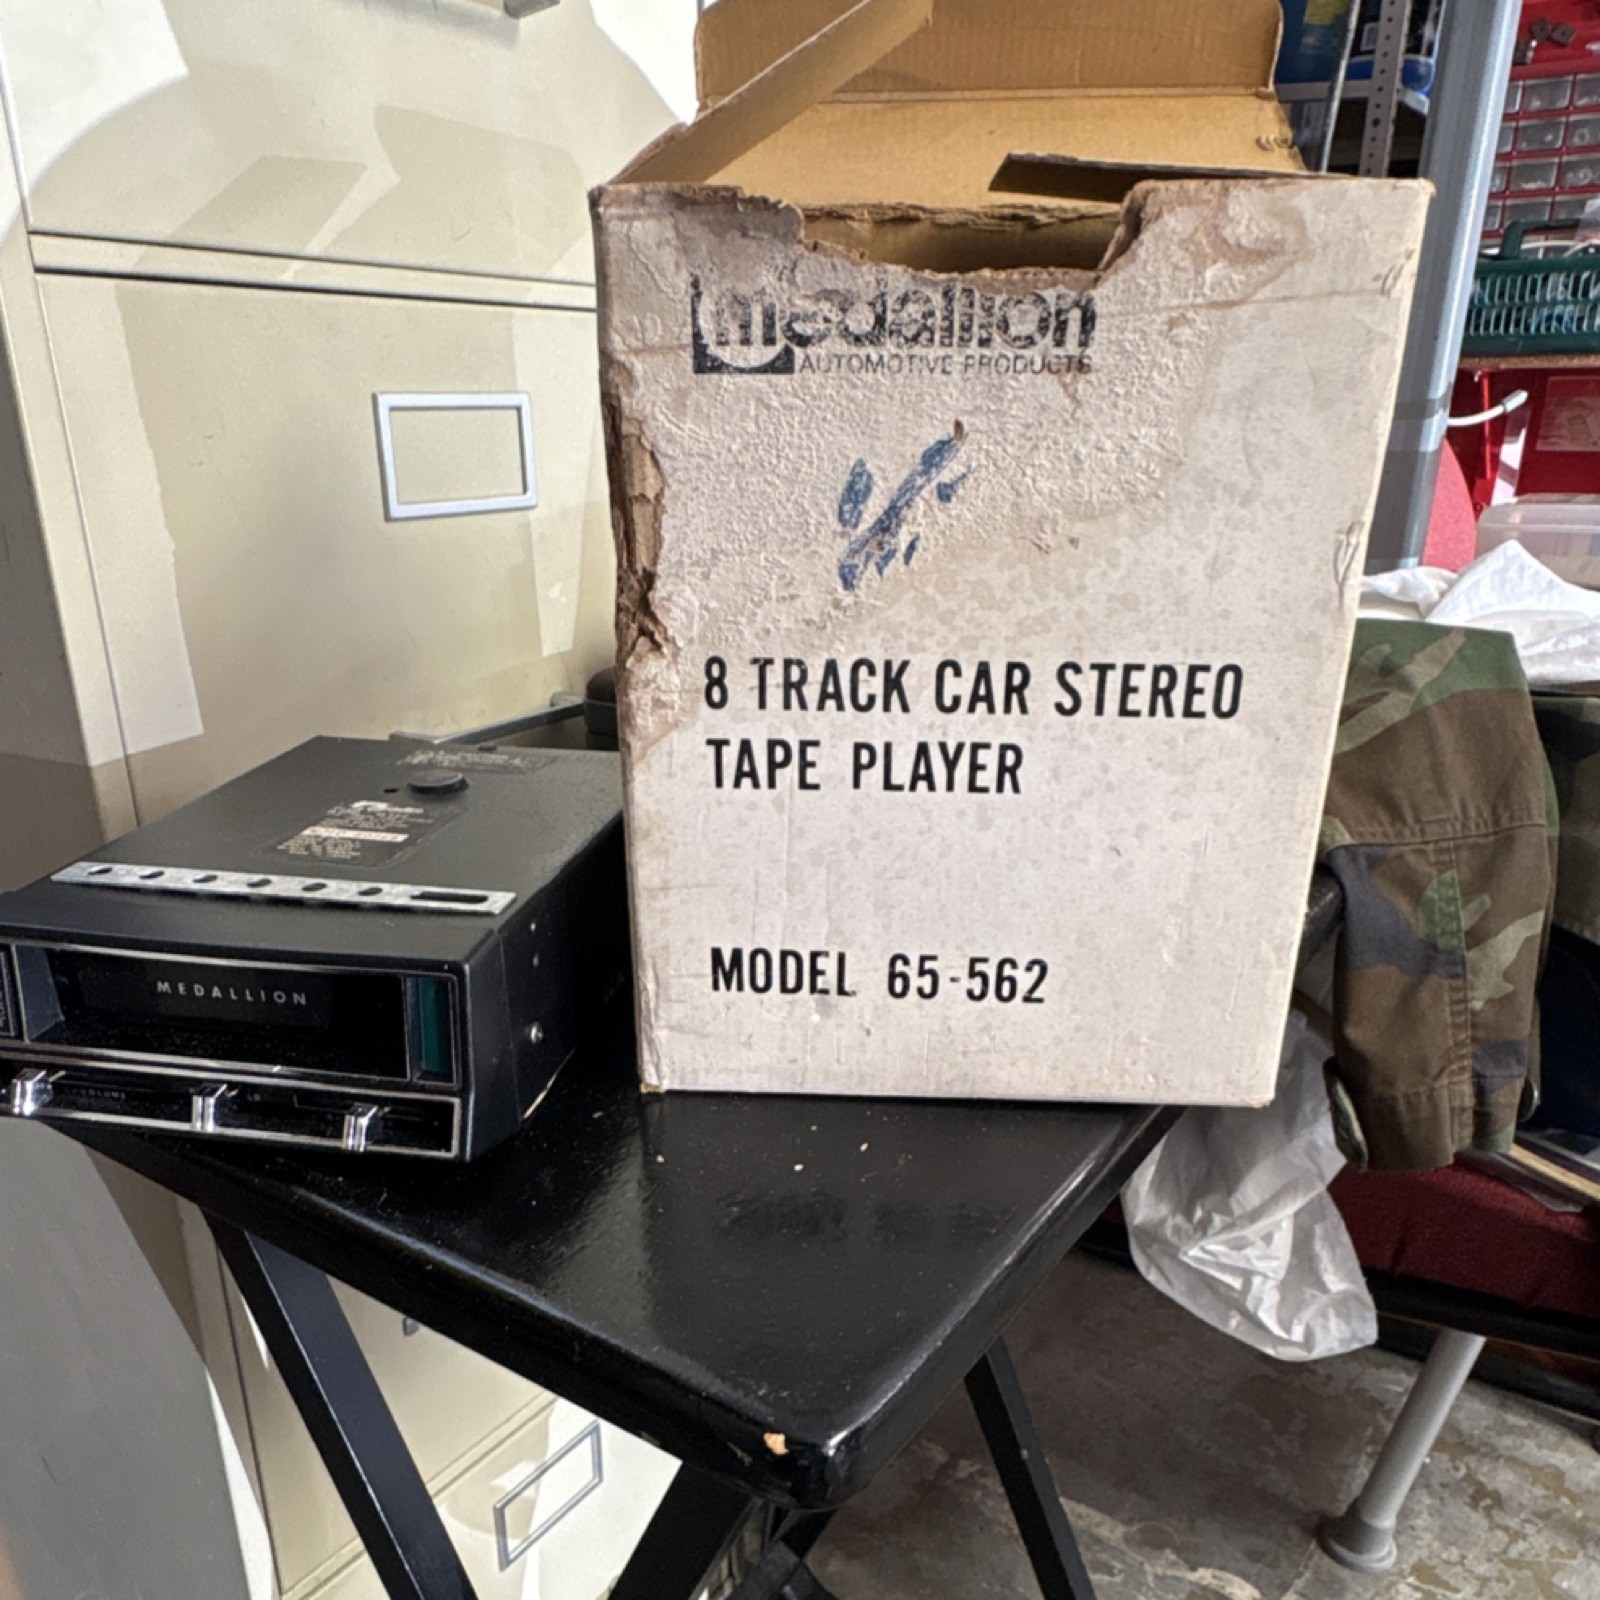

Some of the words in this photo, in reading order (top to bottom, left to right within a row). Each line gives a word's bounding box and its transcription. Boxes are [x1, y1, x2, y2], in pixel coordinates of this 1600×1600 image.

[800, 353, 954, 374] AUTOMOTIVE
[964, 353, 1093, 374] PRODUCTS
[704, 656, 728, 710] 8
[751, 656, 911, 713] TRACK
[935, 659, 1031, 715] CAR
[1054, 660, 1244, 720] STEREO
[706, 737, 821, 790] TAPE
[852, 741, 1024, 794] PLAYER
[156, 978, 308, 1006] MEDALLION
[711, 946, 857, 997] MODEL
[887, 952, 1049, 1004] 65-562
